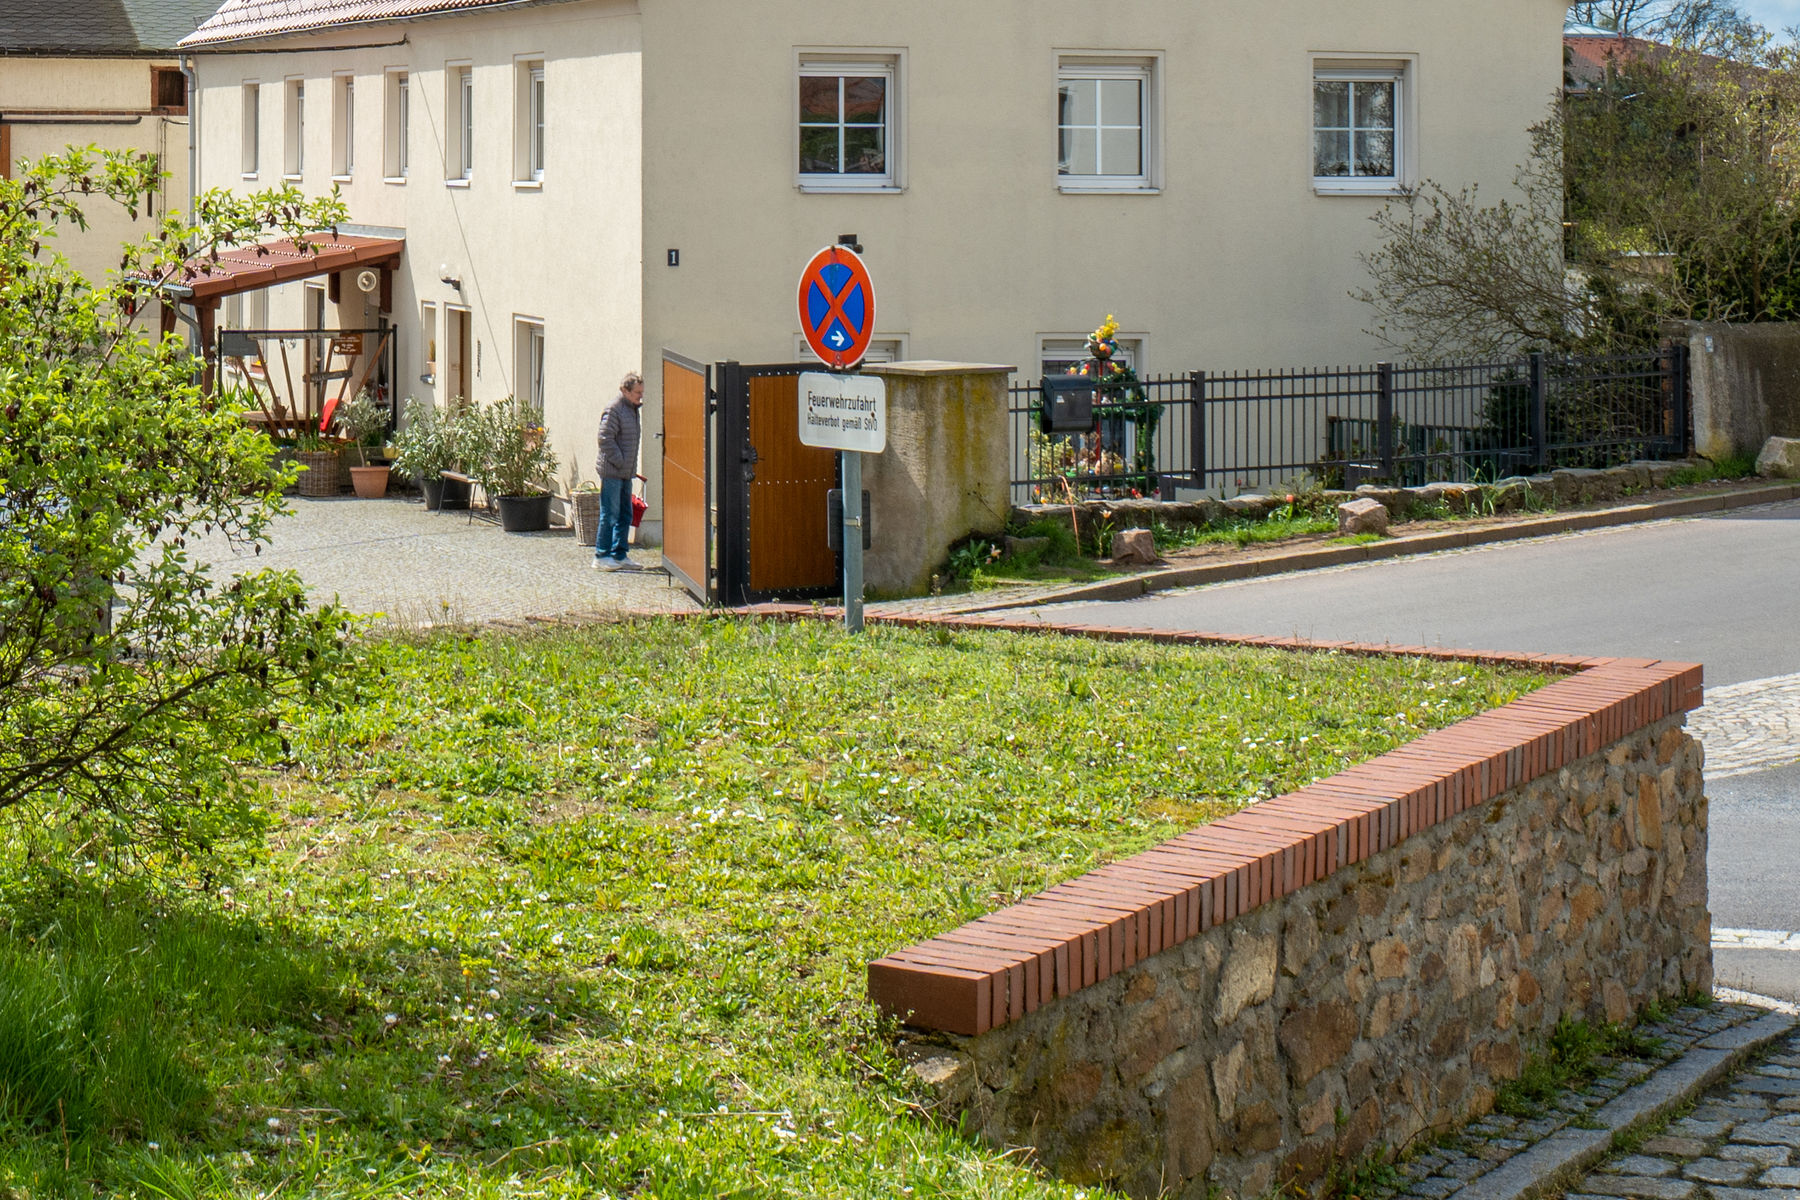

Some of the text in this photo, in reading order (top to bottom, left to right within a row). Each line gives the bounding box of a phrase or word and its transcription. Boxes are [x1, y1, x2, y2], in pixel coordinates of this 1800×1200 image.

[670, 251, 676, 264] 1
[808, 391, 876, 411] Feuerwehrzufahrt
[807, 413, 840, 427] Halteverbot
[842, 416, 861, 431] gemäß
